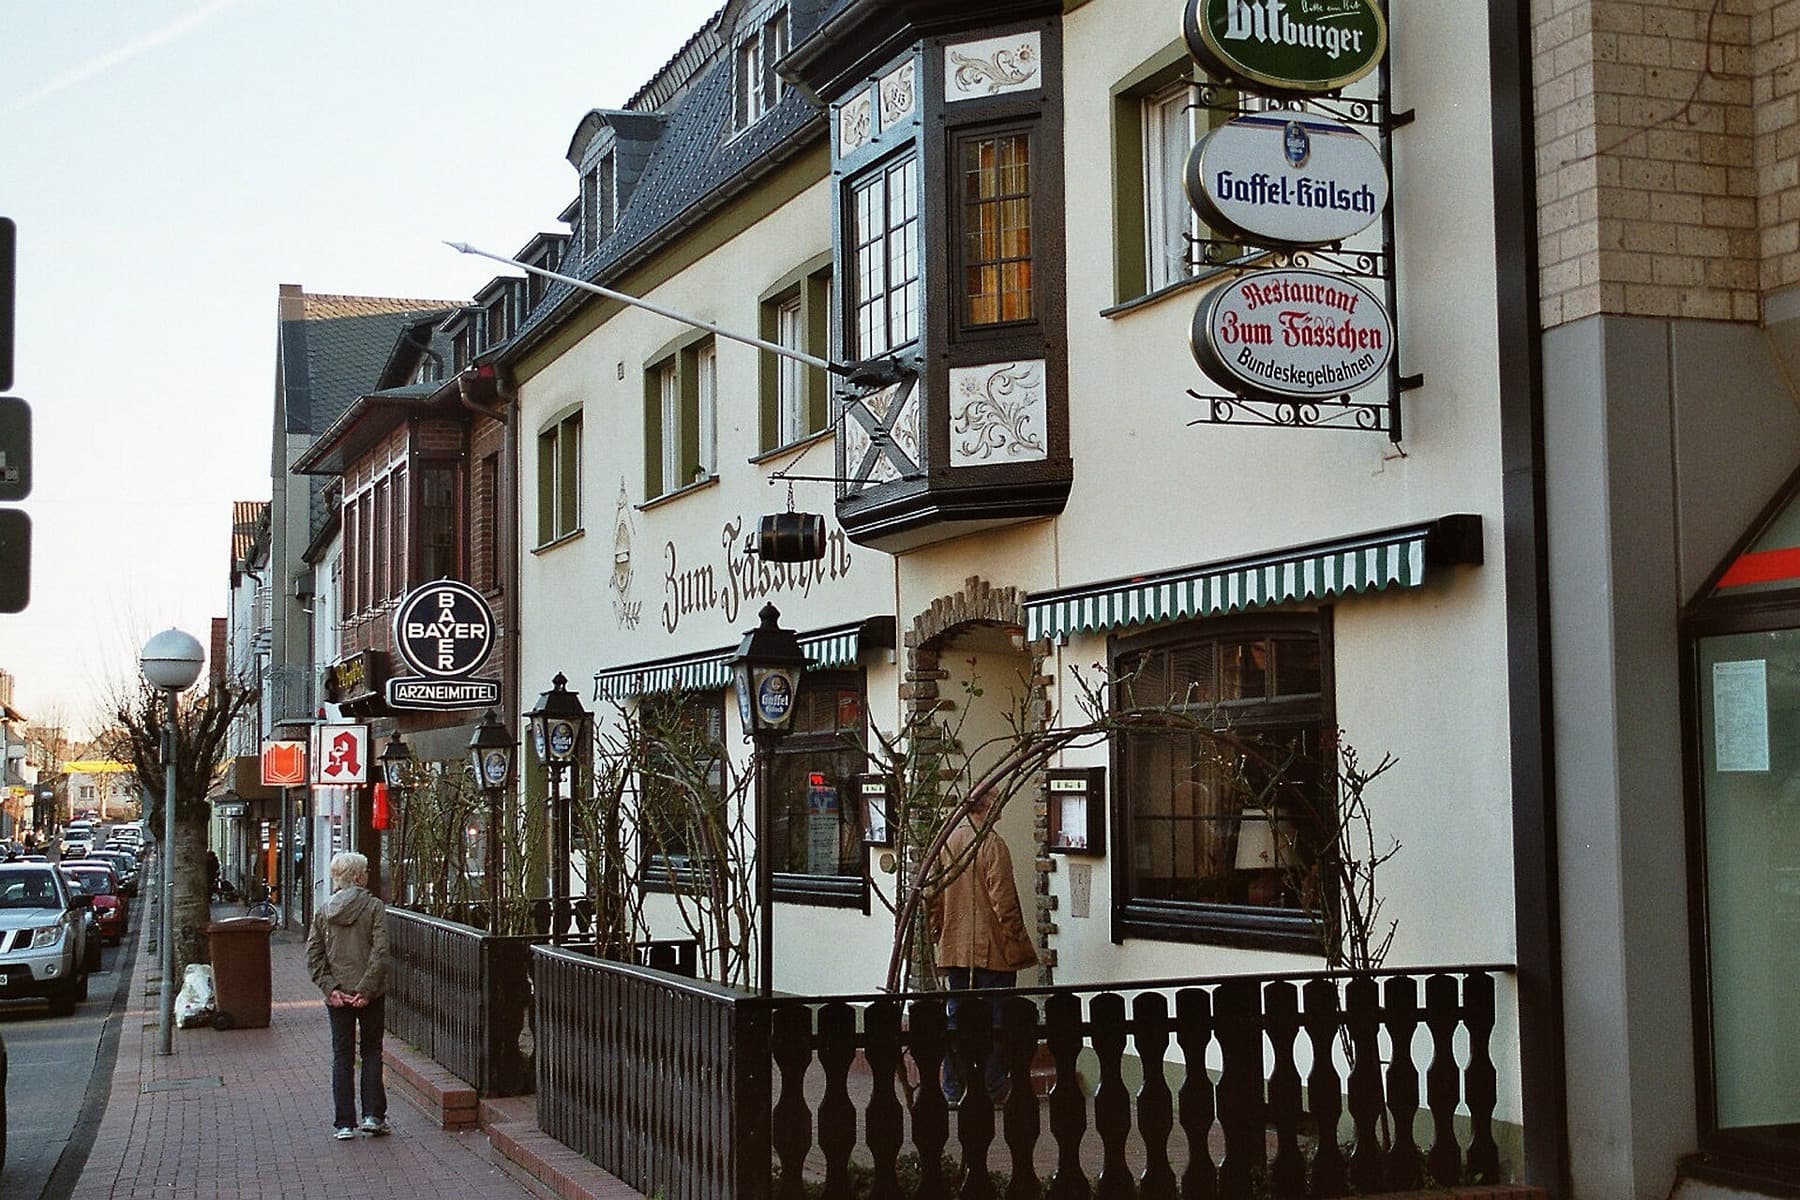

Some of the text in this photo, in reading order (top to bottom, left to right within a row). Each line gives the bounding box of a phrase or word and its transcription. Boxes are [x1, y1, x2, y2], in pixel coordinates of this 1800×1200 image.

[1217, 170, 1376, 215] Gaffel-Kölsch
[1241, 279, 1360, 315] Restaurant
[1220, 310, 1384, 354] Zum Fässchen
[1236, 346, 1376, 388] Bundeskegelbahnen
[662, 540, 718, 635] Zum
[407, 622, 486, 639] BAYER
[438, 592, 456, 670] BAYER
[397, 684, 496, 700] ARZNEIMITTEL
